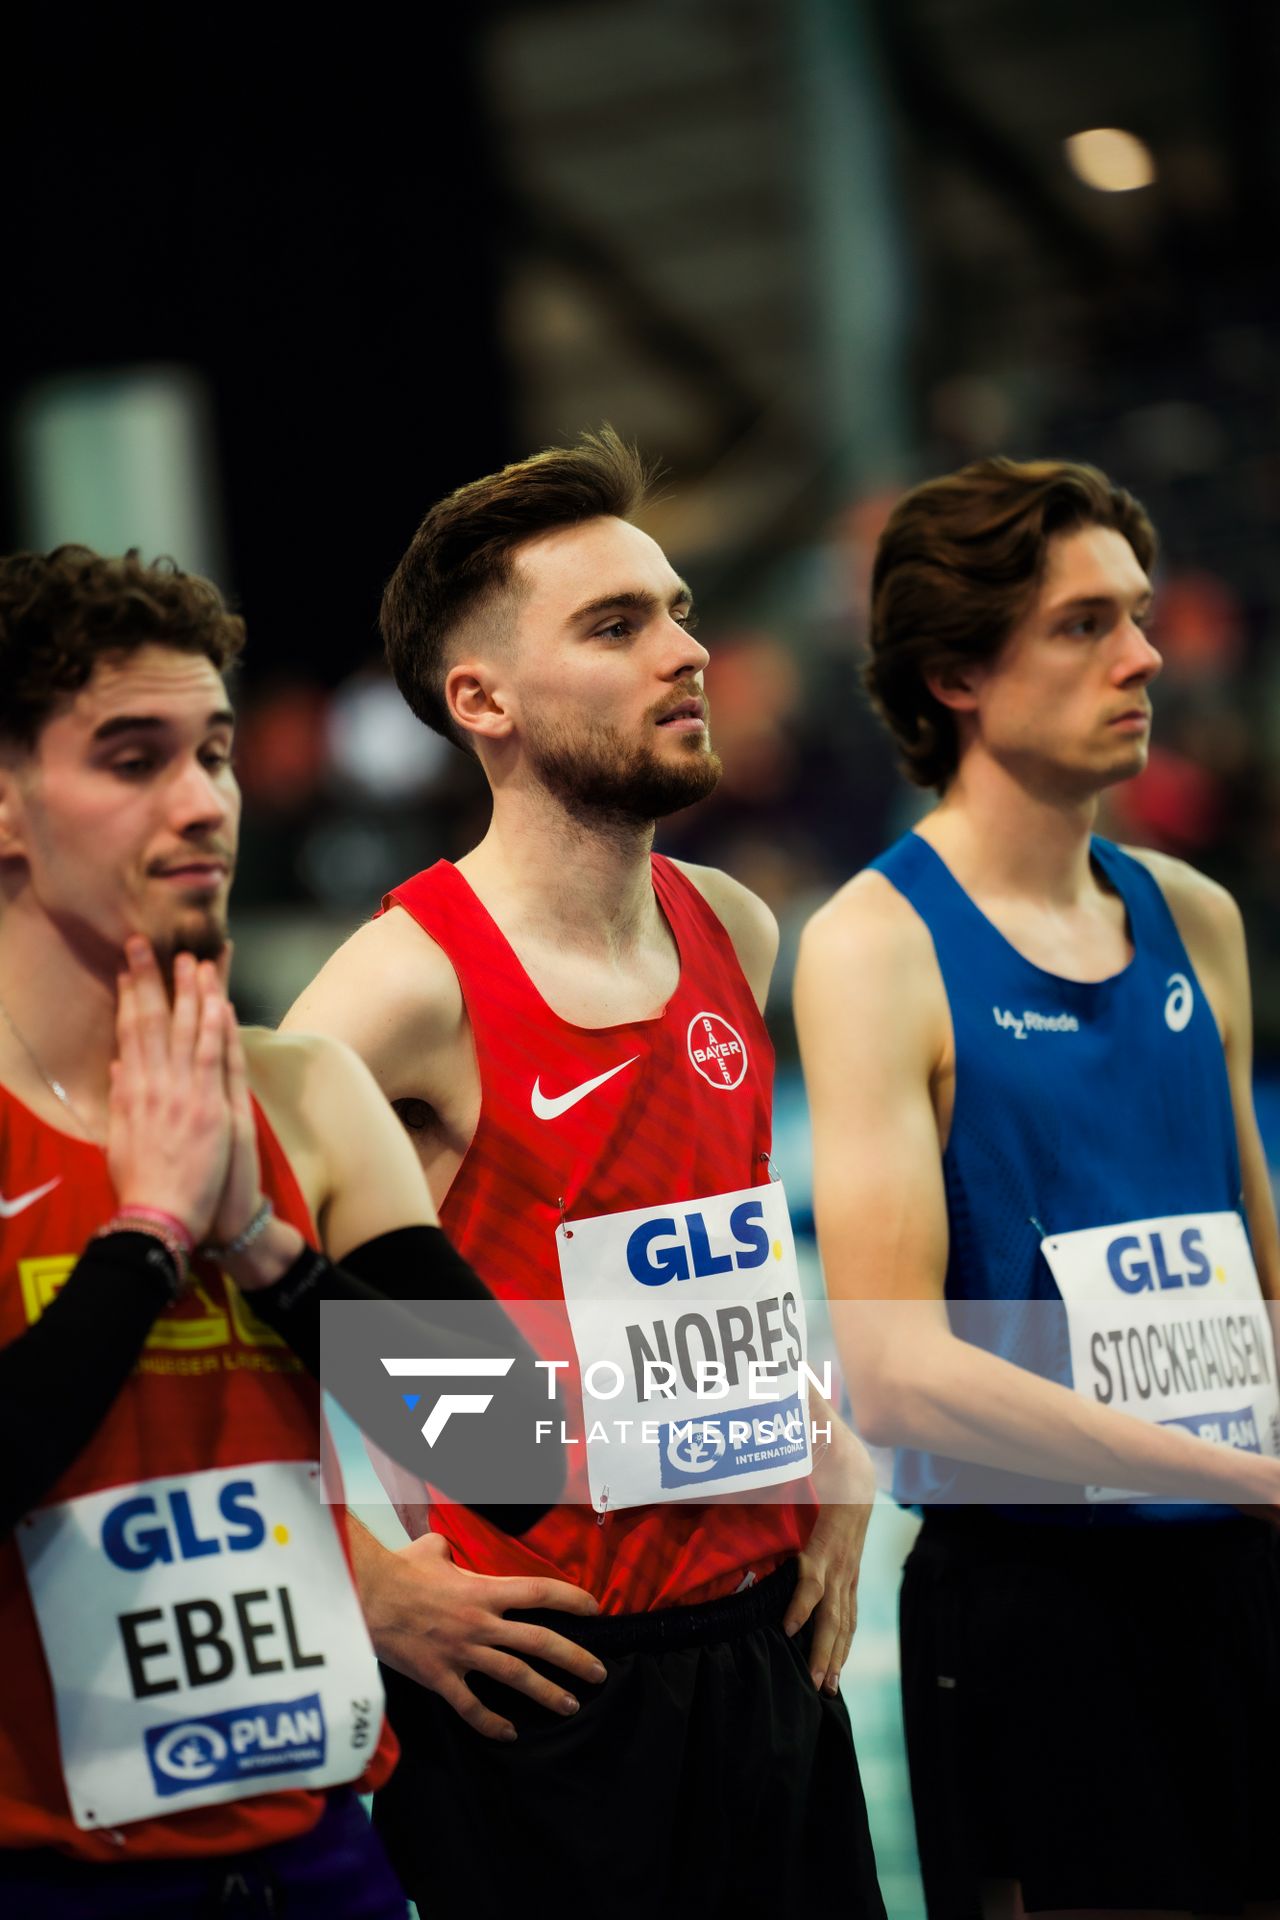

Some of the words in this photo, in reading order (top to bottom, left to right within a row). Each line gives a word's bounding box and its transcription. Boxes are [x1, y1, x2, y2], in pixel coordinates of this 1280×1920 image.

[1023, 1011, 1079, 1032] Rhede
[693, 1041, 742, 1063] BAYER
[702, 1018, 732, 1084] BAYER
[625, 1291, 802, 1403] NORES
[1090, 1314, 1271, 1405] STOCKHAUSEN
[733, 1408, 801, 1450] PLAN
[736, 1442, 804, 1465] INTERNATIONAL
[117, 1586, 326, 1701] EBEL
[231, 1708, 322, 1754] PLAN
